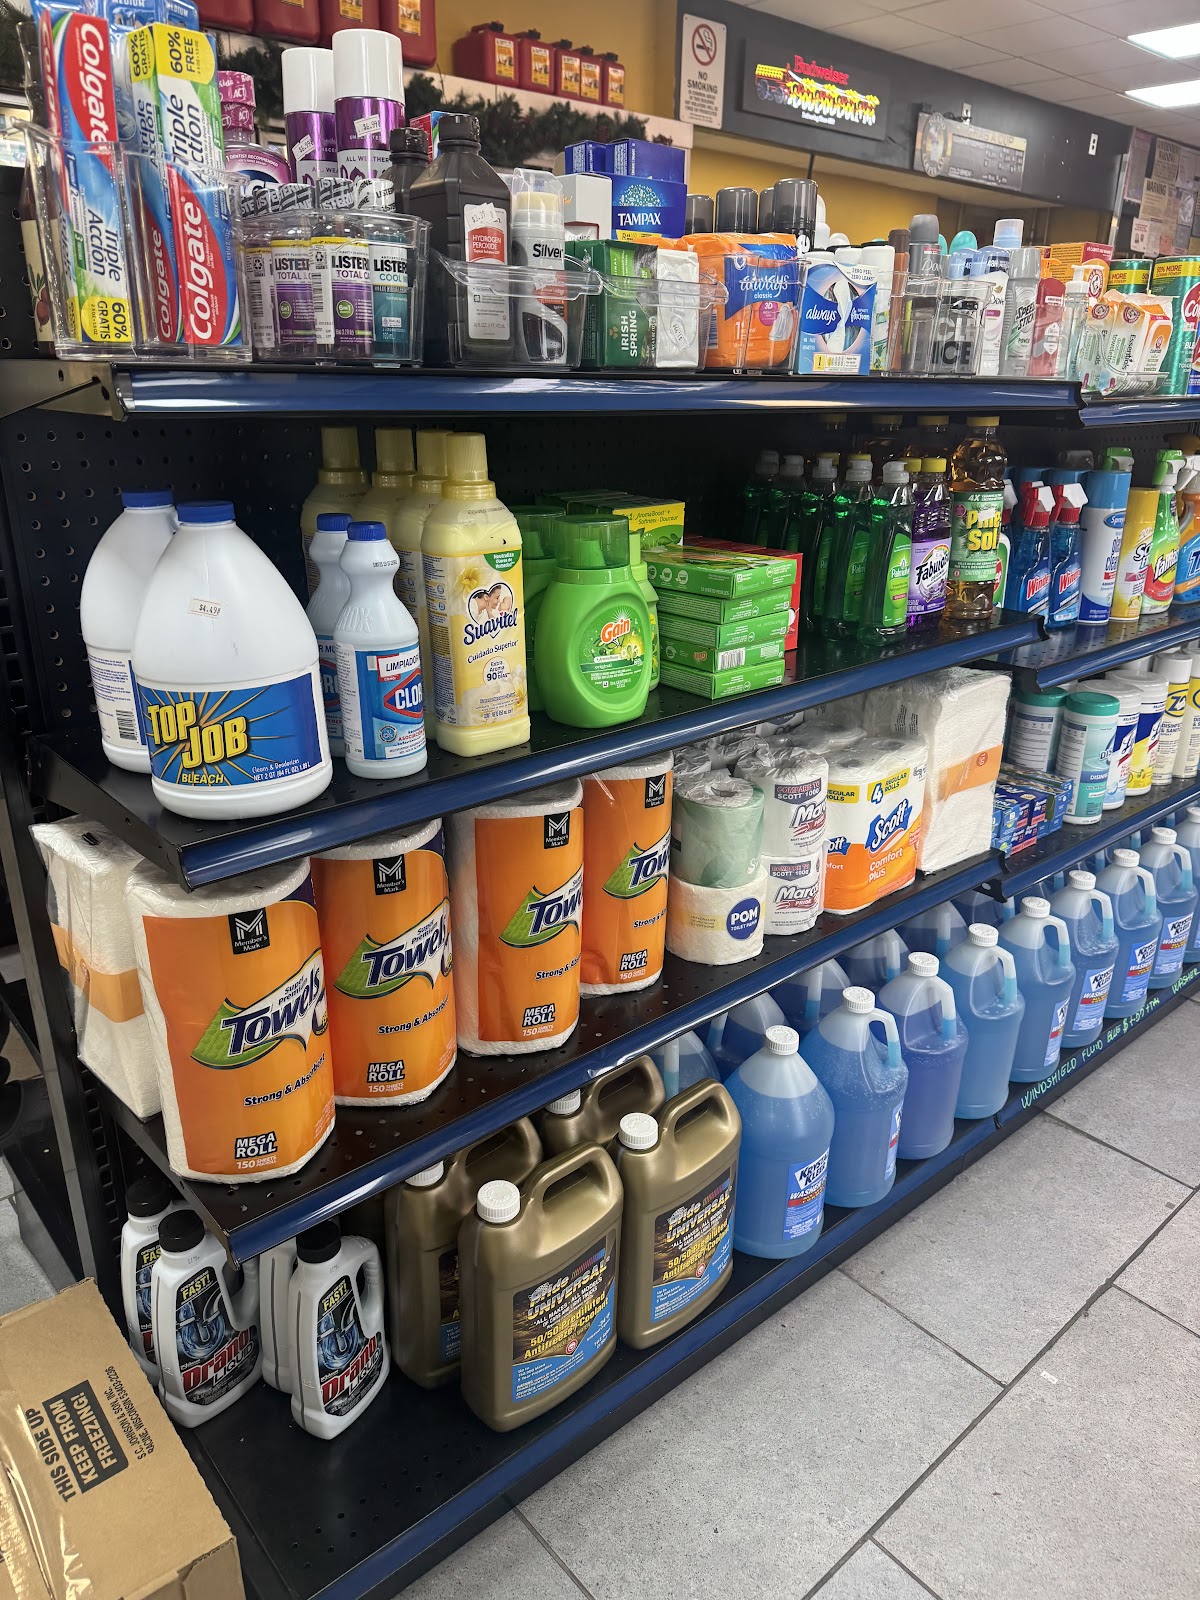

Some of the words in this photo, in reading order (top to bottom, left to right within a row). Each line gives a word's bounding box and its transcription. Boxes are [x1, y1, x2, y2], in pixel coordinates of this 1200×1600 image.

[130, 33, 141, 77] 60%
[139, 30, 148, 76] GRATIS
[167, 31, 183, 74] 60%
[183, 37, 196, 73] FREE
[698, 71, 708, 81] NO
[793, 54, 849, 86] Budweiser
[79, 22, 111, 144] Colgate
[233, 83, 247, 100] ACT
[687, 79, 718, 94] SMOKING
[166, 94, 190, 166] Triple
[247, 154, 279, 168] RECOMMENDED
[1146, 181, 1167, 196] WARNING
[617, 212, 662, 227] TAMPAX
[87, 208, 107, 276] Acción
[472, 234, 502, 244] HYDROGEN
[472, 241, 498, 251] PEROXIDE
[104, 229, 122, 282] Triple
[532, 243, 563, 259] Silver
[184, 200, 214, 340] Colgate
[336, 269, 363, 280] TOTAL
[379, 272, 403, 283] COOL
[1111, 272, 1128, 281] MORE
[1165, 264, 1183, 273] MORE
[153, 229, 171, 340] Colgate
[740, 272, 790, 298] always
[764, 302, 773, 310] 3D
[805, 304, 838, 326] always
[97, 300, 111, 340] GRATIS
[111, 302, 129, 340] 60%
[620, 315, 630, 352] IRISH
[629, 310, 638, 358] SPRING
[931, 340, 973, 365] ICE
[1121, 334, 1137, 371] Essentials
[968, 494, 981, 502] 4X
[638, 517, 657, 525] Softness
[659, 515, 679, 523] Douceur
[967, 528, 998, 551] Sol
[463, 607, 519, 647] Suavitel
[600, 618, 631, 644] Gain
[466, 647, 494, 664] Cuidado
[493, 639, 519, 654] Superior
[486, 672, 498, 682] 90
[489, 665, 506, 673] Aroma
[147, 699, 198, 746] TOP
[181, 715, 249, 770] JOB
[251, 766, 269, 775] Cleans
[274, 758, 300, 770] Deodorizes
[253, 772, 265, 782] NET
[181, 772, 225, 785] BLEACH
[776, 782, 812, 794] COMPARE
[884, 781, 901, 793] ROLLS
[885, 771, 908, 786] REGULAR
[777, 792, 803, 800] SCOTT
[805, 787, 821, 798] 1000
[871, 782, 884, 805] 4
[871, 799, 908, 849] Scott
[545, 834, 569, 845] Member's
[550, 839, 565, 848] Mark
[869, 847, 904, 871] Comfort
[376, 877, 406, 889] Member's
[772, 870, 794, 878] SCOTT
[795, 868, 810, 876] 1000
[868, 867, 887, 883] Plus
[383, 885, 402, 894] Mark
[416, 918, 435, 935] Super
[633, 915, 658, 929] Strong
[730, 906, 759, 926] POM
[411, 920, 439, 946] Premium
[730, 922, 746, 932] TOILET
[234, 934, 269, 948] Member's
[243, 942, 262, 952] Mark
[361, 914, 448, 988] Towels
[620, 957, 648, 971] ROLL
[621, 949, 648, 962] MEGA
[534, 967, 564, 981] Strong
[563, 963, 571, 973] &
[619, 971, 633, 980] 150
[1171, 967, 1200, 995] WASHER
[278, 977, 308, 1005] Premium
[284, 974, 305, 995] Super
[220, 965, 321, 1058] Towels
[523, 1012, 556, 1026] ROLL
[525, 1003, 555, 1016] MEGA
[377, 1020, 412, 1035] Strong
[412, 1017, 421, 1028] &
[522, 1026, 538, 1036] 150
[367, 1070, 406, 1083] ROLL
[368, 1060, 405, 1073] MEGA
[1020, 1057, 1078, 1110] WINDSHIELD
[1081, 1039, 1104, 1062] FLUID
[1106, 1024, 1122, 1044] BLUE
[243, 1088, 284, 1108] Strong
[284, 1083, 294, 1097] &
[294, 1052, 327, 1092] Absorbent
[368, 1084, 385, 1093] 150
[235, 1132, 278, 1150] MEGA
[235, 1143, 278, 1159] ROLL
[236, 1159, 257, 1170] 150
[256, 1155, 278, 1164] SHEETS
[666, 1185, 733, 1243] UNIVERSAL
[667, 1247, 694, 1269] 50/50
[693, 1218, 729, 1252] Prediluted
[182, 1274, 211, 1301] FAST!
[323, 1282, 348, 1312] FAST!
[527, 1255, 610, 1321] UNIVERSAL
[570, 1291, 581, 1304] ALL
[581, 1276, 604, 1298] MODELS
[530, 1323, 561, 1348] 50/50
[560, 1290, 607, 1331] Prediluted
[181, 1328, 251, 1395] Drano
[212, 1341, 255, 1387] LIQUID
[321, 1335, 378, 1406] Drano
[104, 1365, 129, 1400] 53403-2236
[103, 1386, 116, 1402] INC.
[109, 1397, 124, 1416] SON,
[121, 1397, 145, 1432] WISCONSIN
[25, 1407, 46, 1430] UP
[49, 1398, 80, 1444] FROM
[70, 1391, 118, 1470] FREEZING!
[119, 1418, 140, 1448] JOHNSON
[138, 1427, 156, 1455] RACINE,
[33, 1427, 61, 1466] SIDE
[134, 1444, 147, 1461] S.C.
[68, 1443, 99, 1485] KEEP
[49, 1464, 77, 1503] THIS
